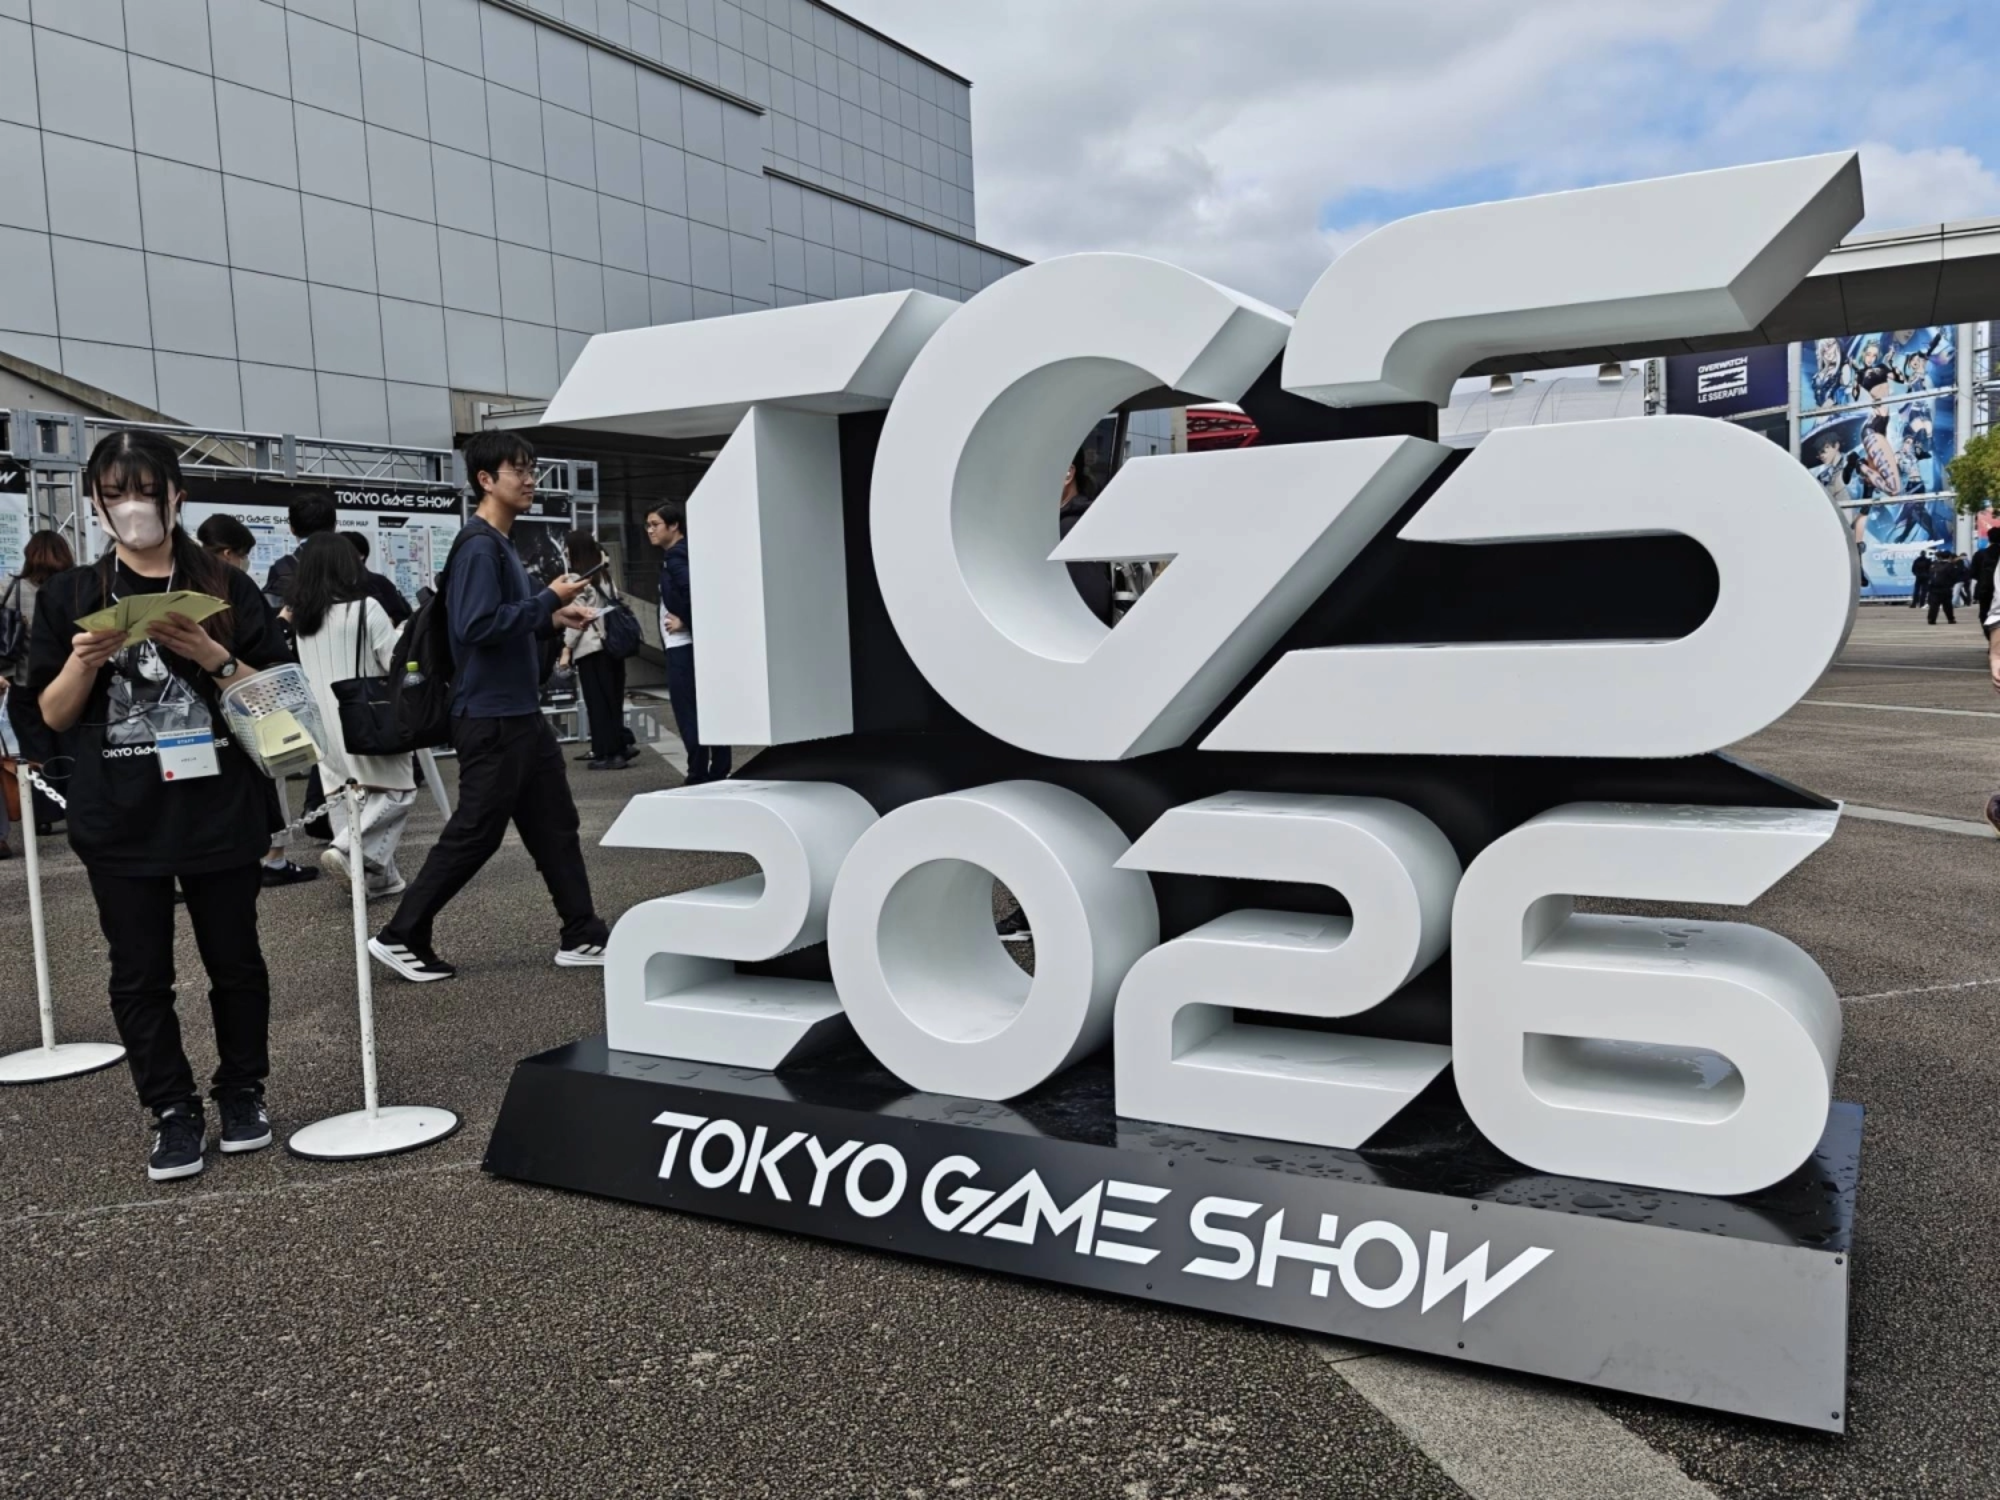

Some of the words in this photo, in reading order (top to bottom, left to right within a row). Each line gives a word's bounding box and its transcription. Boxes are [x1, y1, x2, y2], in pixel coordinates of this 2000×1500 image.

[1698, 356, 1748, 373] OVERWATCH
[1698, 394, 1707, 403] LE
[1708, 386, 1748, 402] SSERAFIM
[541, 150, 1863, 761] TGS
[334, 491, 380, 505] TOKYO
[381, 493, 415, 506] GAME
[417, 495, 456, 508] SHOW
[246, 514, 272, 524] GAME
[102, 747, 133, 758] OKYO
[134, 745, 158, 756] GAM
[214, 738, 229, 748] 26
[600, 778, 1844, 1196] 2026
[651, 1110, 908, 1217] TOKYO
[921, 1155, 1172, 1265] GAME
[1181, 1196, 1555, 1322] SHOW
